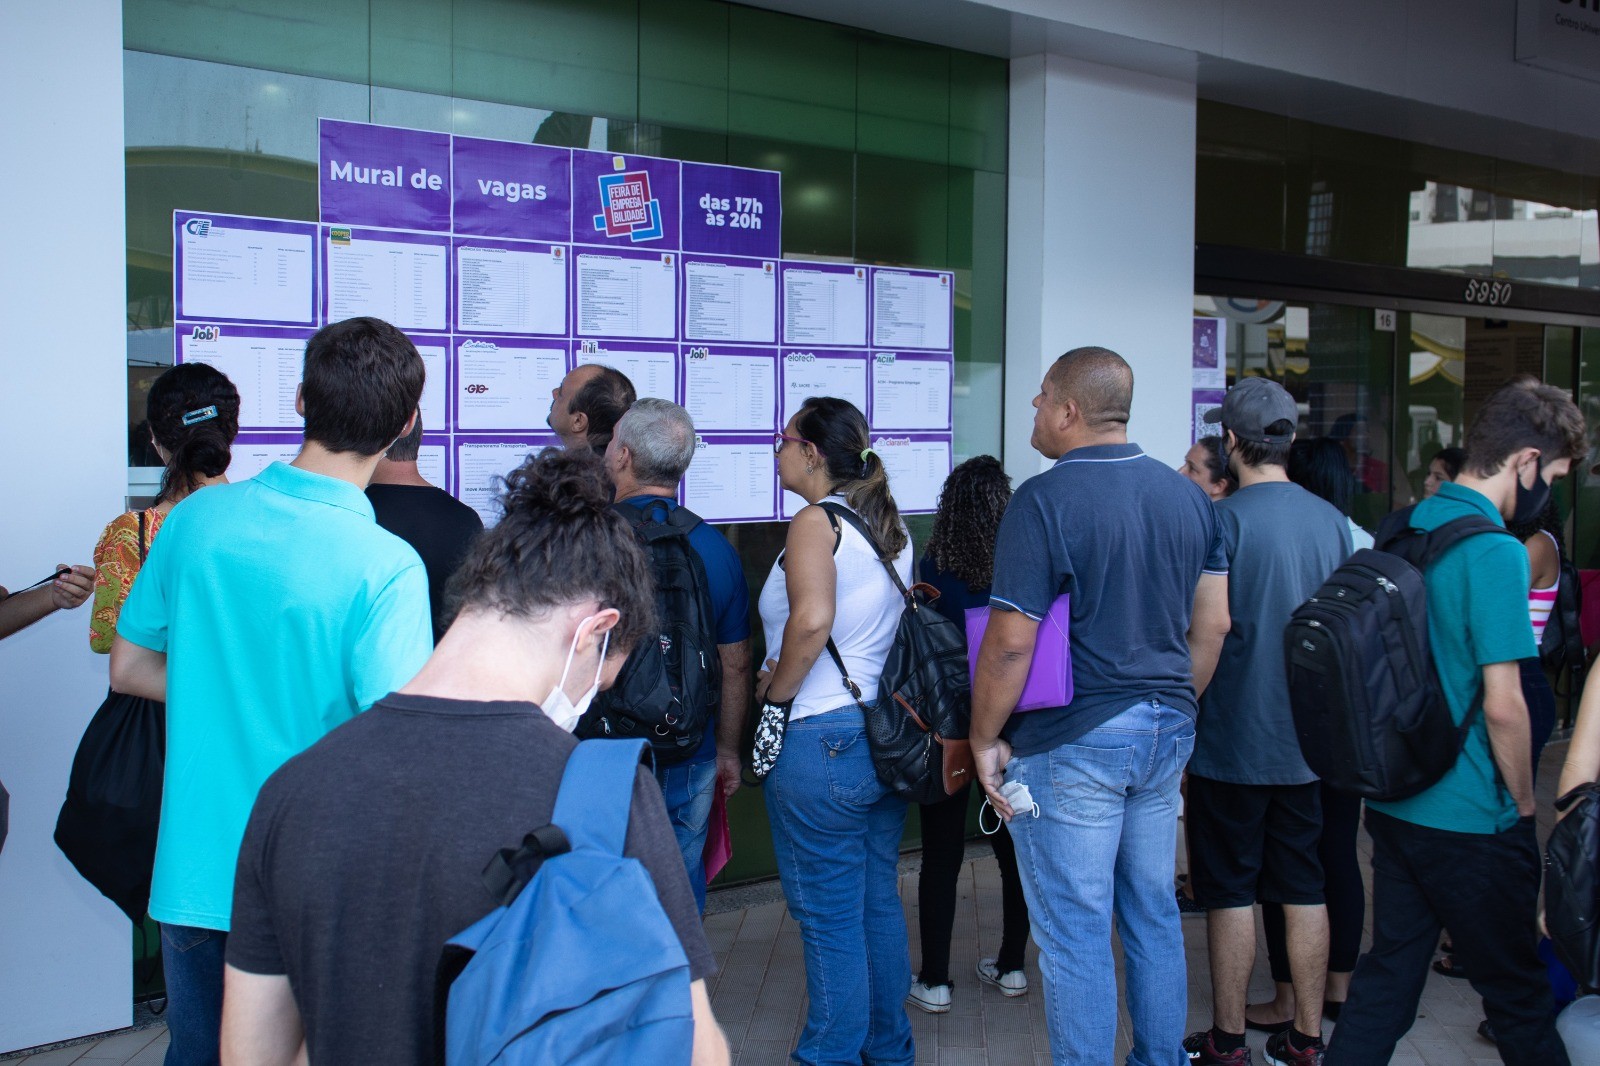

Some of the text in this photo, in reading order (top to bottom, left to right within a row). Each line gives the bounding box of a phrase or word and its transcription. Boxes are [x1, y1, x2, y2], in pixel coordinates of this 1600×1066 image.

[330, 160, 547, 203] Mural de vagas
[610, 184, 641, 199] FEIRA DE
[611, 196, 643, 211] EMPREGA
[699, 193, 763, 214] das 17h
[613, 209, 645, 223] BILIDADE
[705, 208, 762, 230] às 20h
[1465, 279, 1512, 305] 5950
[1380, 314, 1391, 327] 16
[192, 327, 219, 341] Job!
[689, 349, 708, 361] Job!
[787, 353, 816, 363] elotech
[886, 438, 909, 446] claranet
